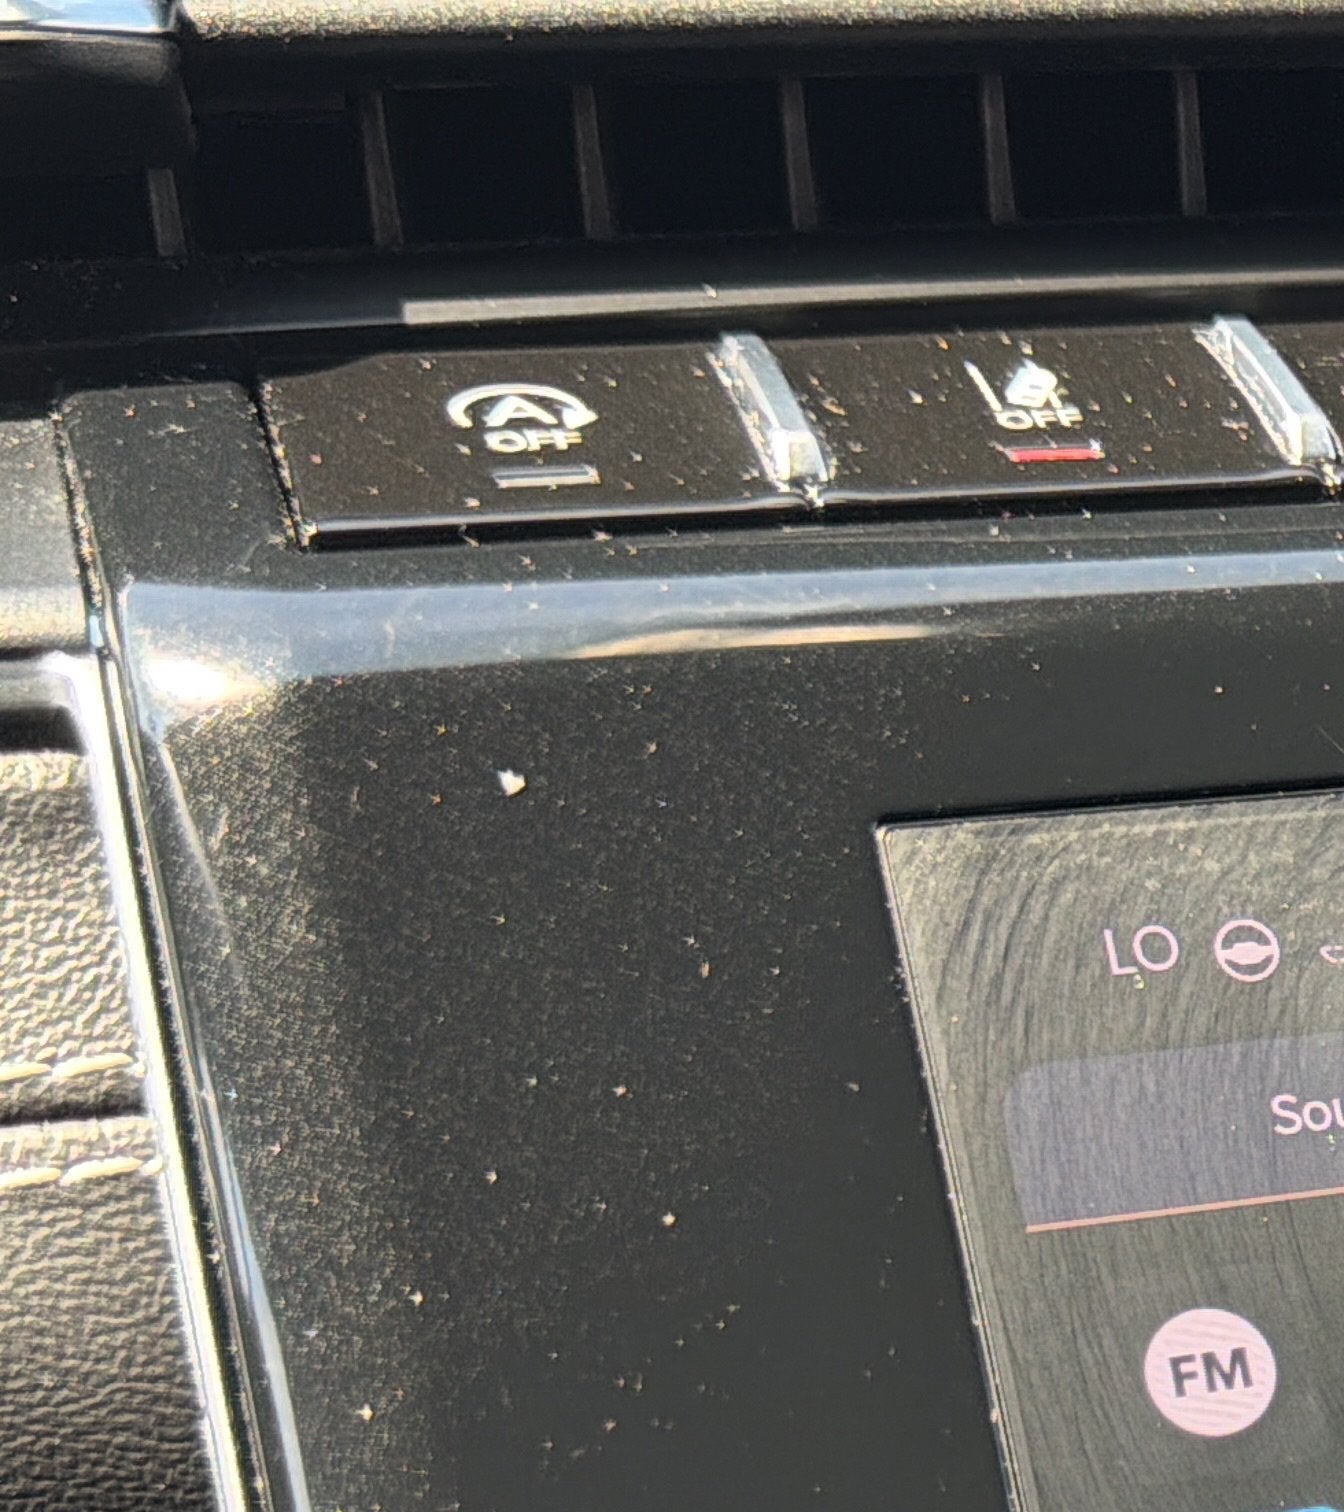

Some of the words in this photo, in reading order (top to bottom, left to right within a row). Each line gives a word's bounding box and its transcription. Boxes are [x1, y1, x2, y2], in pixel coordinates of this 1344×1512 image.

[996, 403, 1084, 430] OFF
[483, 428, 583, 453] OFF
[1104, 925, 1179, 976] LO
[1169, 1346, 1254, 1398] FM
